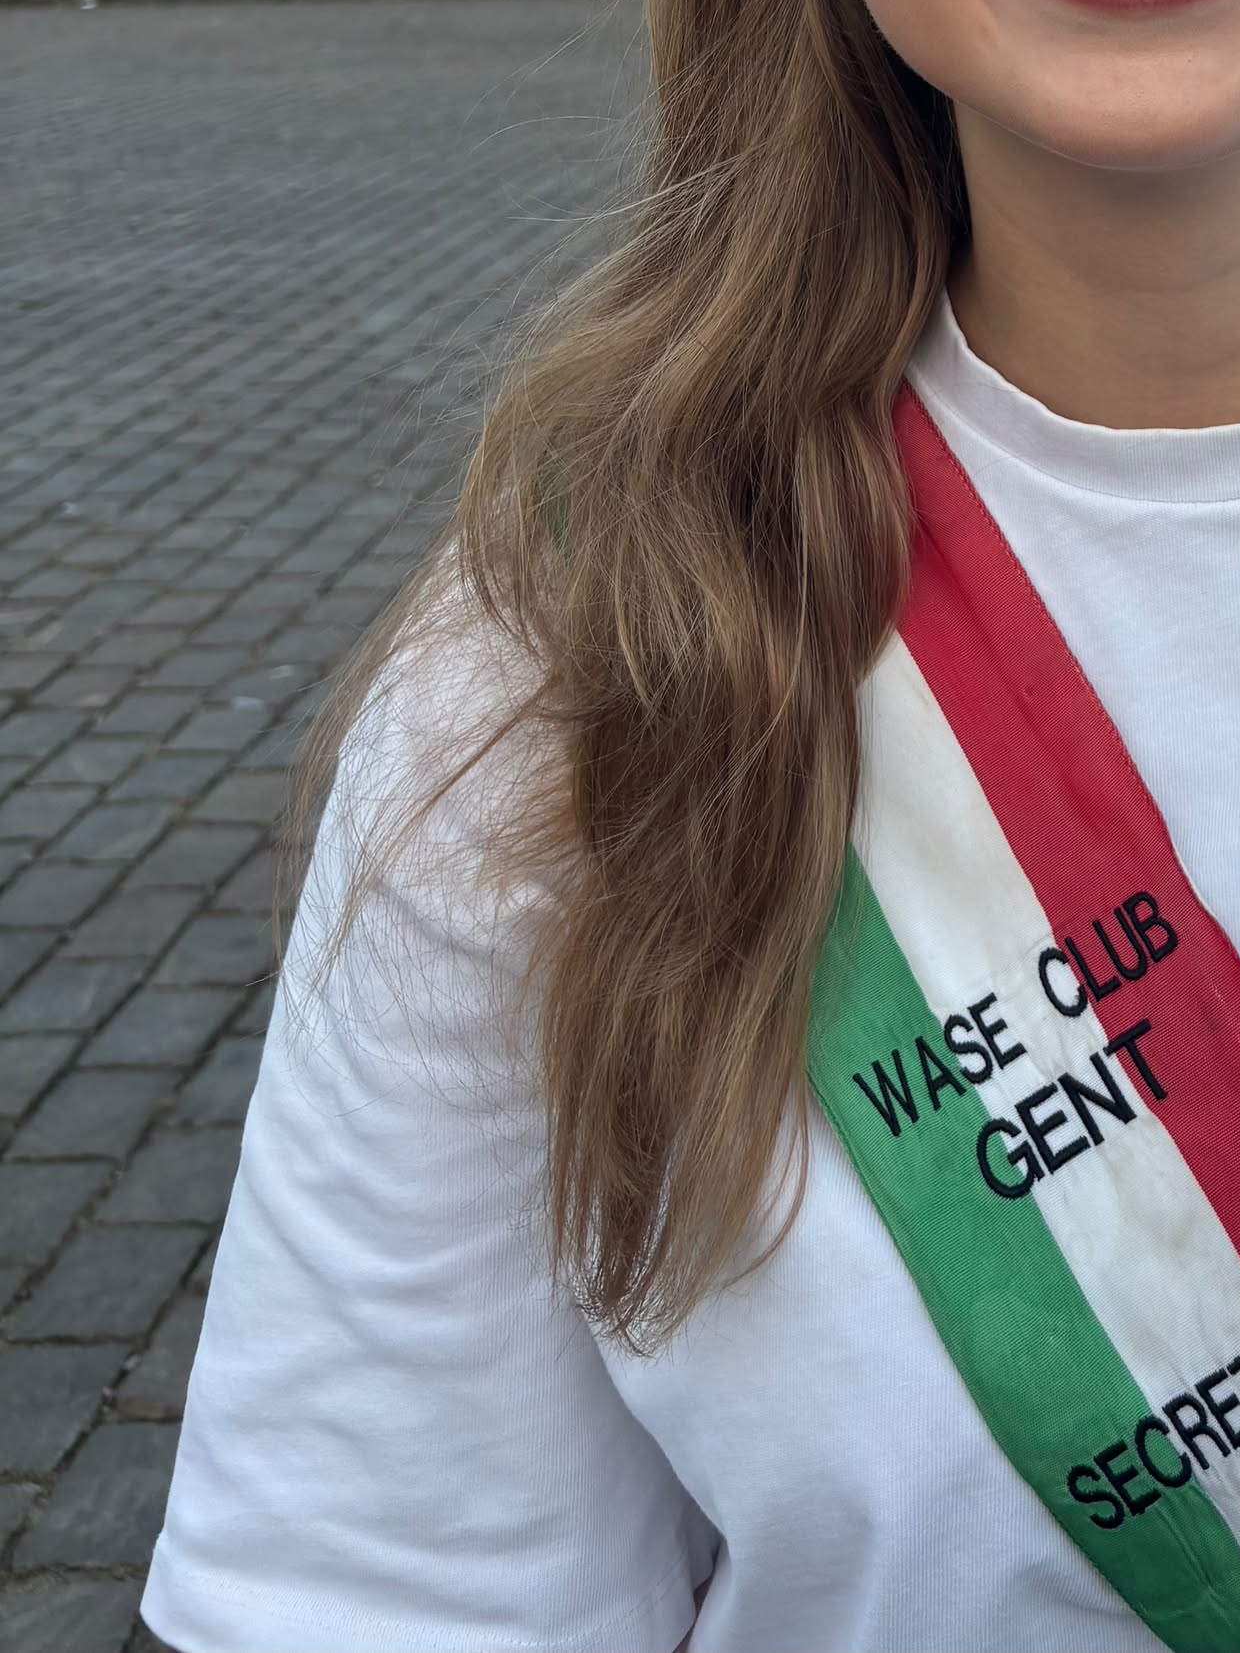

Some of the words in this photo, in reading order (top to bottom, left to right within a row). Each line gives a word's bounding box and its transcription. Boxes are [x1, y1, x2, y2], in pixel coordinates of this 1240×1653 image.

[852, 993, 1027, 1138] WASE
[1038, 891, 1179, 1019] CLUB
[976, 1019, 1169, 1200] GENT
